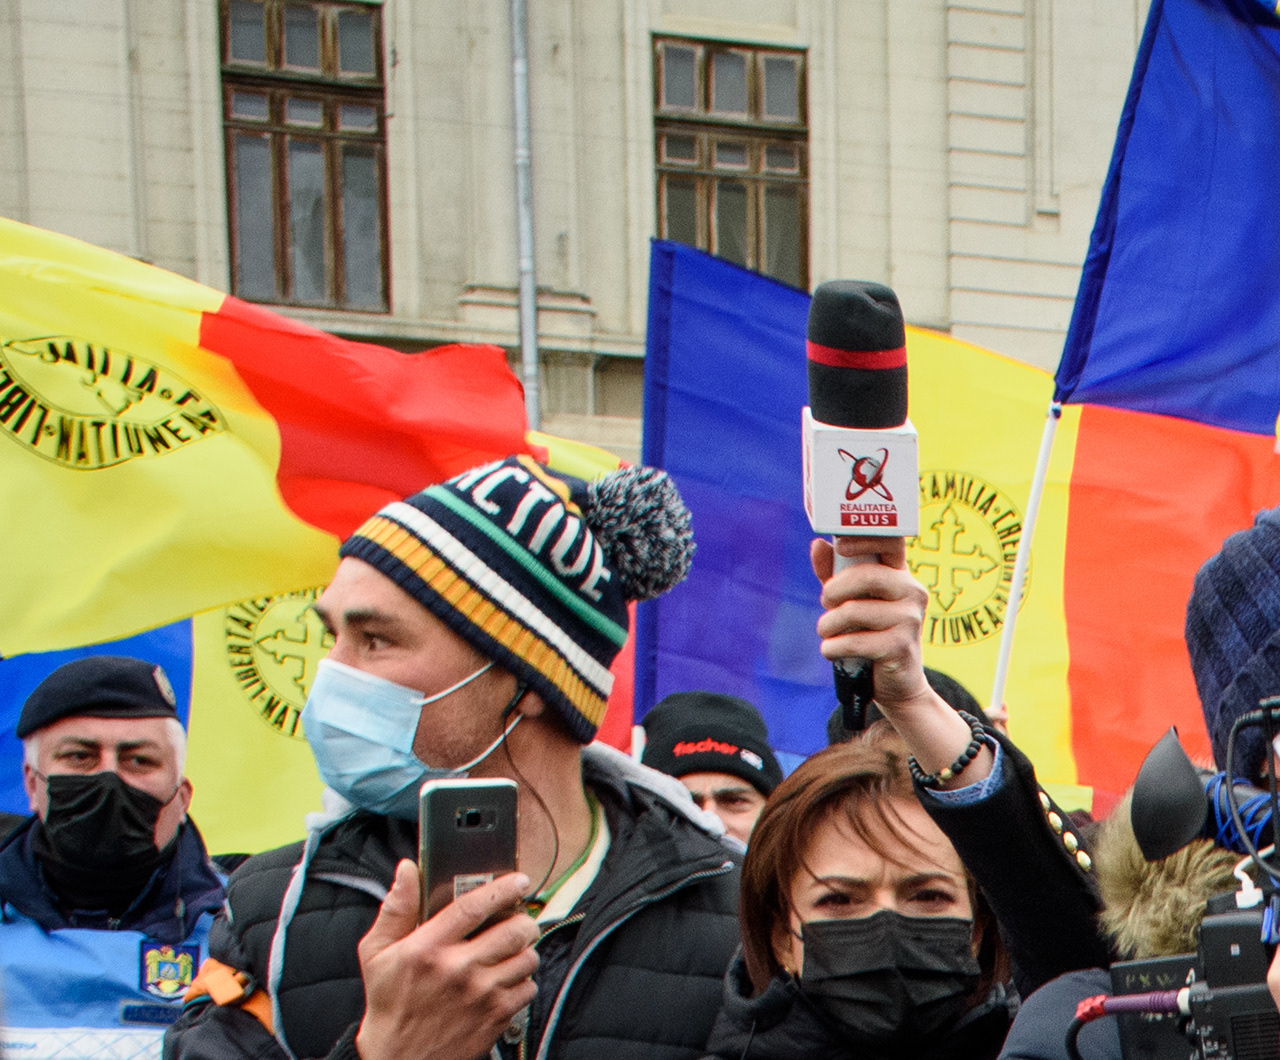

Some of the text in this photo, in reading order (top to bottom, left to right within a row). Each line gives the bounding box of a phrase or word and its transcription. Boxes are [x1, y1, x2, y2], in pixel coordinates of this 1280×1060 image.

[841, 504, 897, 512] REALITATEA
[850, 514, 890, 525] PLUS
[928, 604, 1004, 645] TIUNEA
